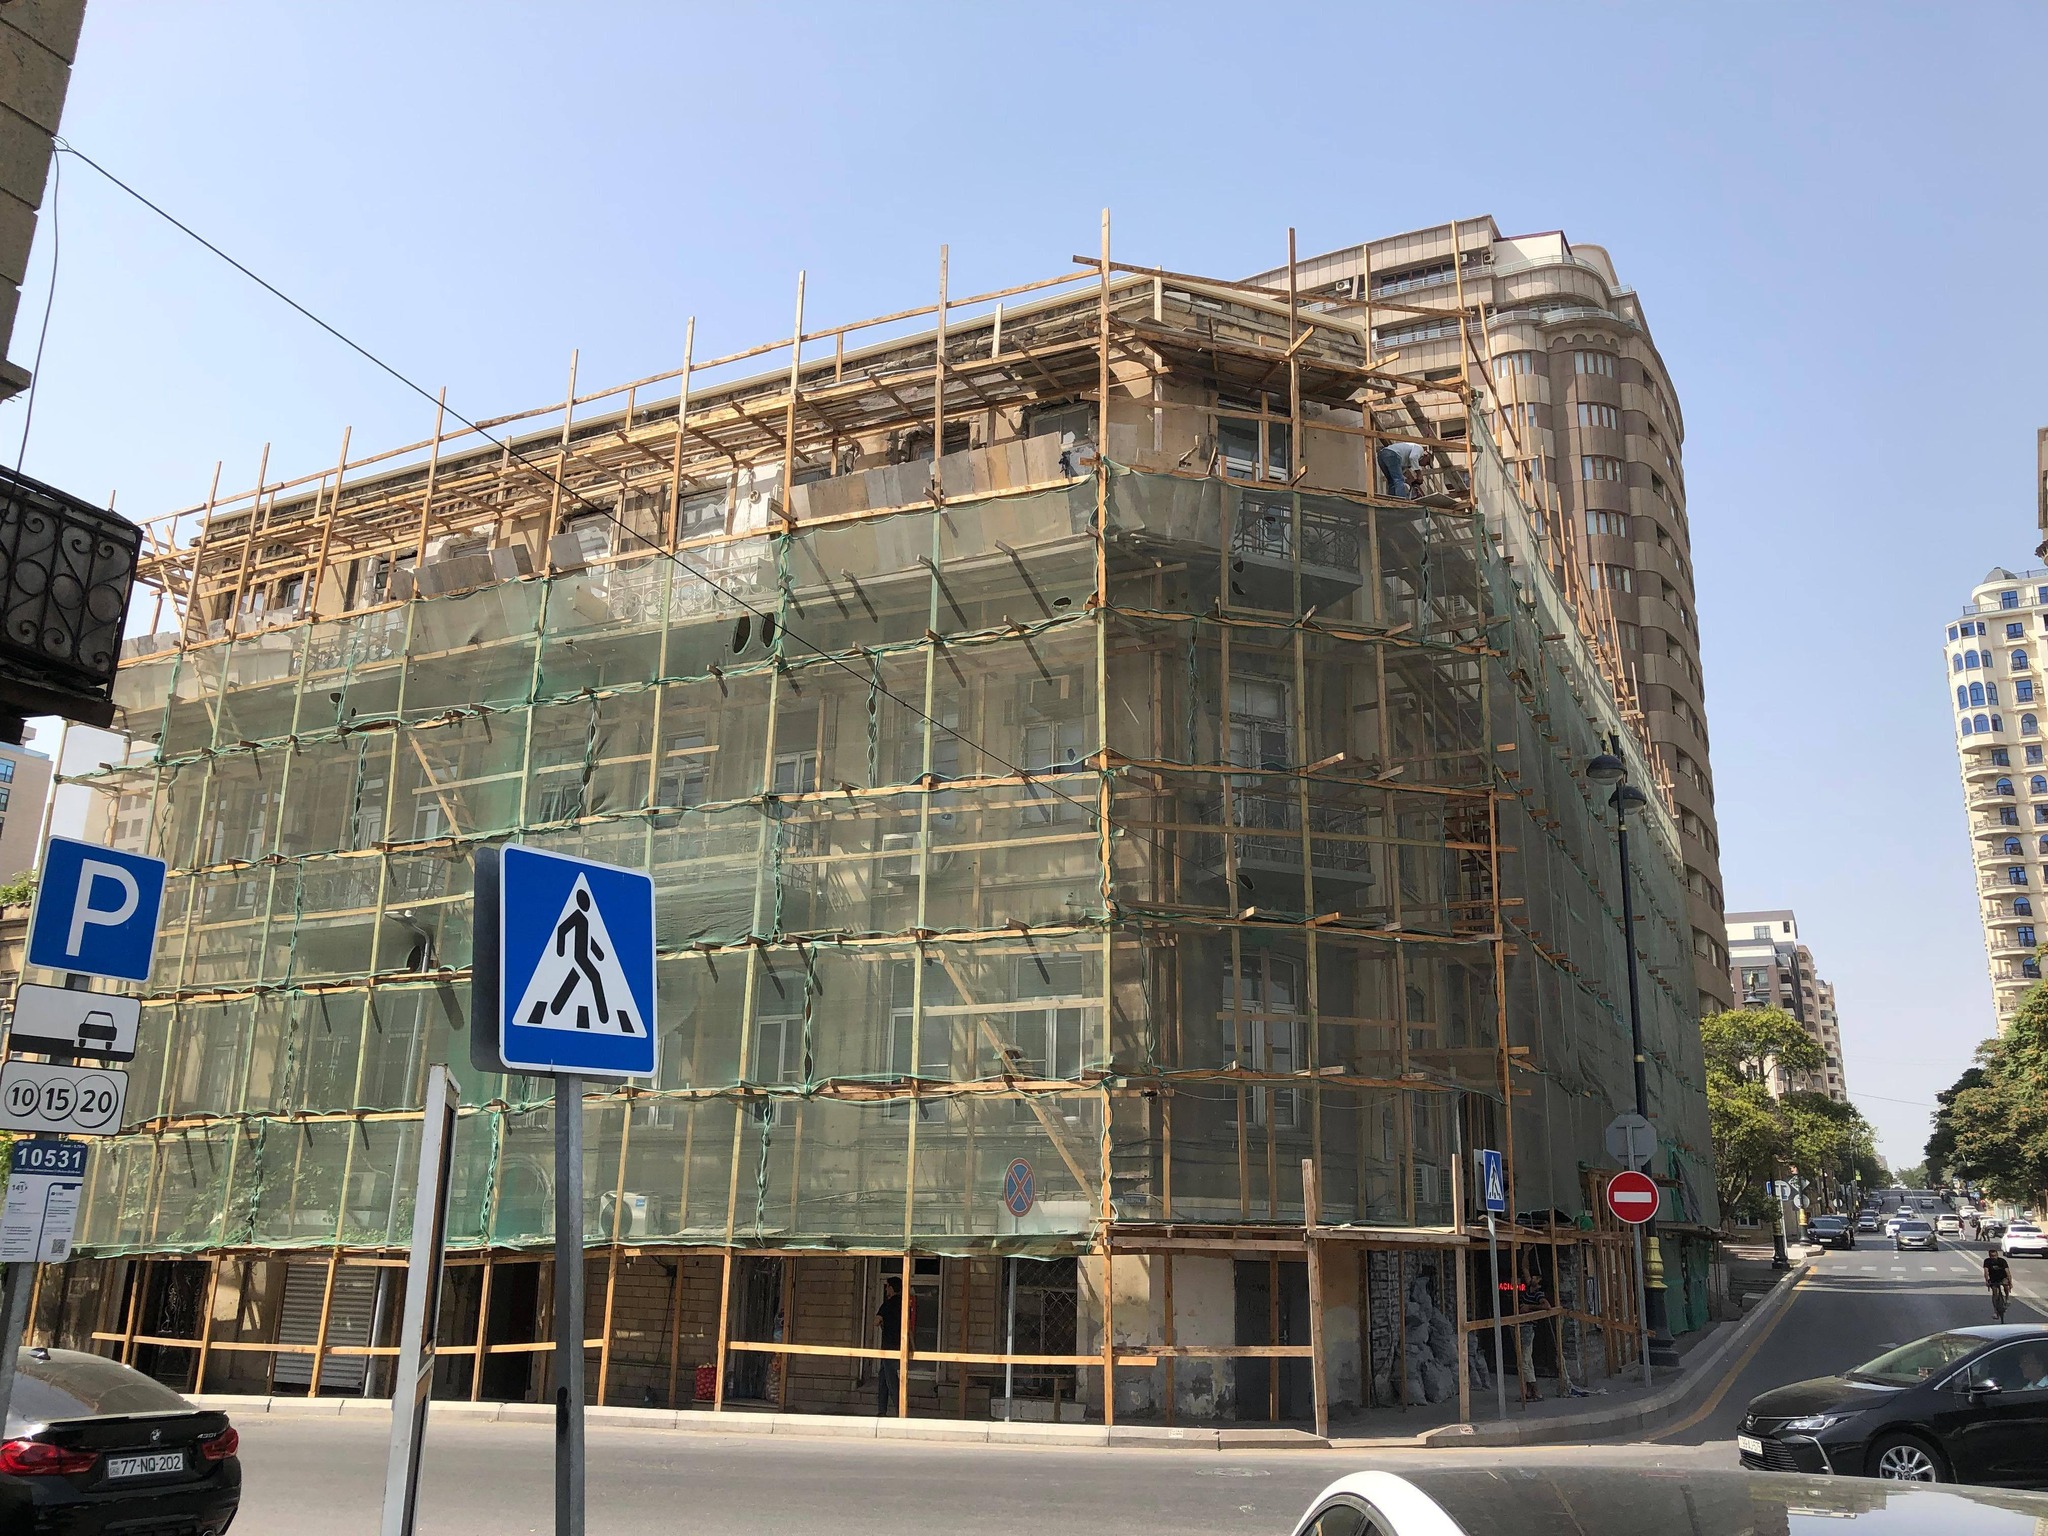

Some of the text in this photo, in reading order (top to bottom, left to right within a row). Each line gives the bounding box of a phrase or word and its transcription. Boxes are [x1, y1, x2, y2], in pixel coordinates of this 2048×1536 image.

[65, 858, 140, 957] P
[12, 1087, 113, 1114] 10 15 20
[18, 1148, 82, 1169] 10531
